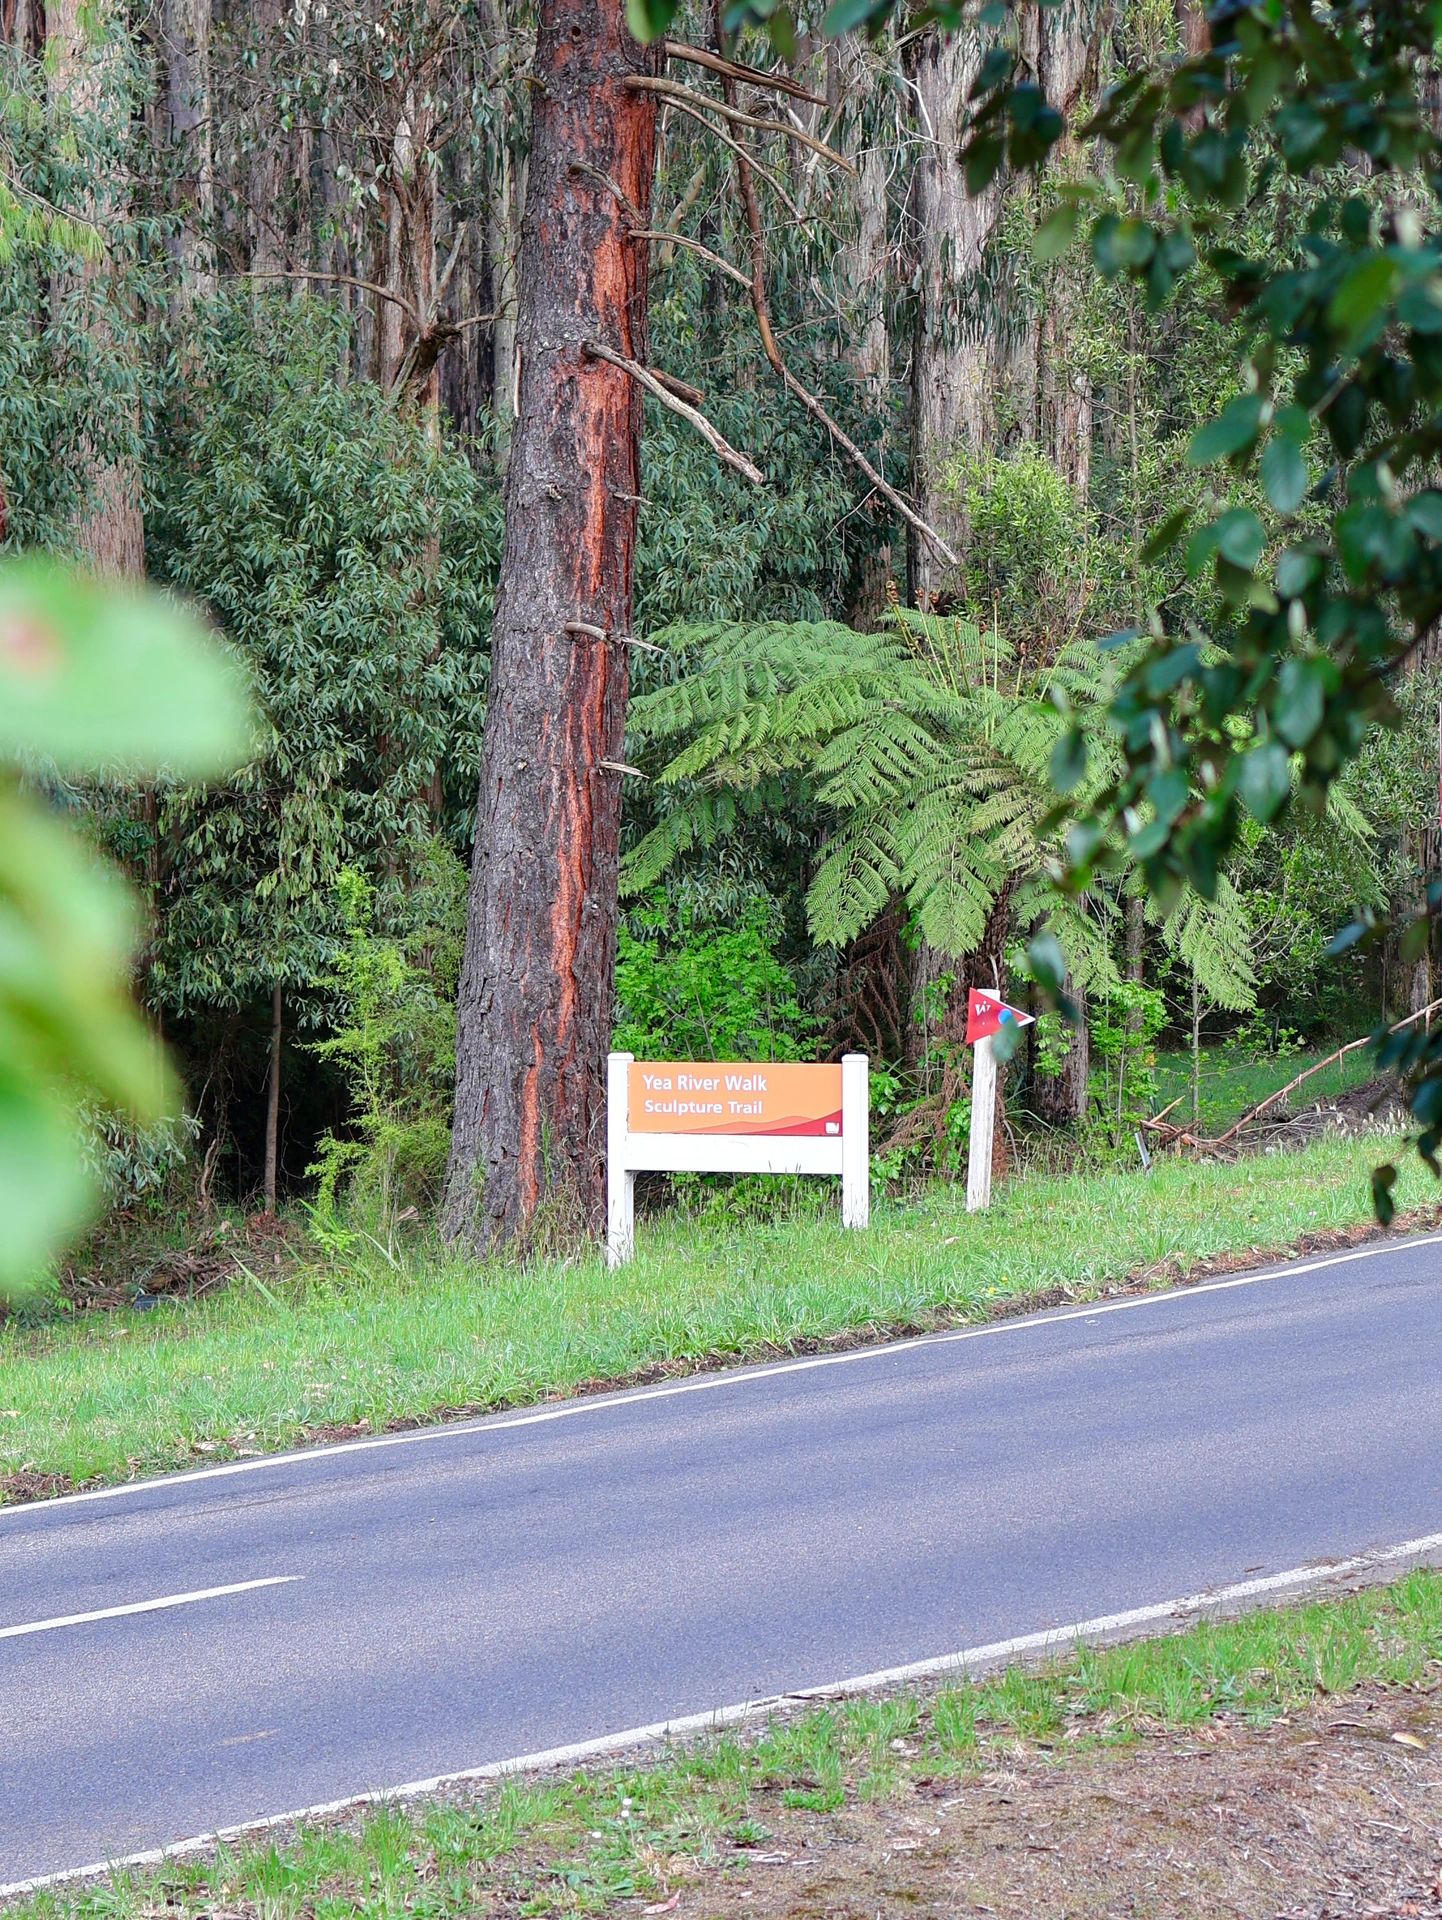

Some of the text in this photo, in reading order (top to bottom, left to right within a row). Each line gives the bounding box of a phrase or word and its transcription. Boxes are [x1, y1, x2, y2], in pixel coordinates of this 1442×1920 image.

[643, 1075, 767, 1091] Yea River Walk
[644, 1100, 762, 1116] Sculpture Trail
